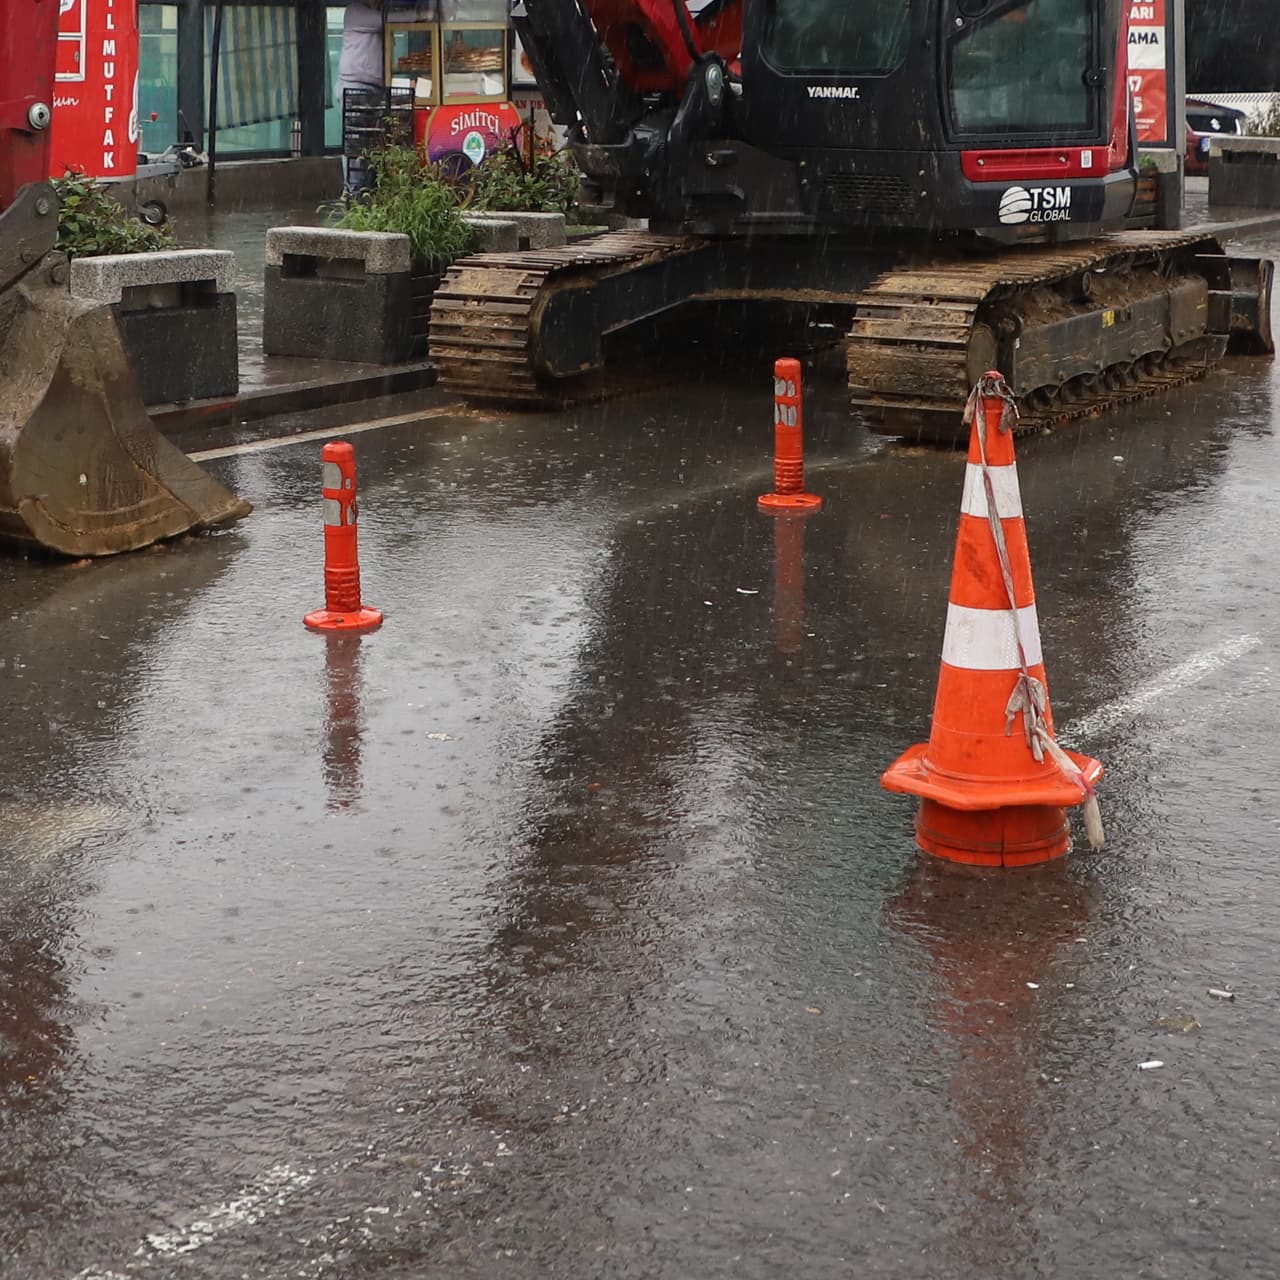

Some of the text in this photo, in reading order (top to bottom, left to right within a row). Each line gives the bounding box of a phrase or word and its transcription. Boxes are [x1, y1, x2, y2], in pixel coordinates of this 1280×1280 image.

[102, 39, 116, 169] MUTFAK
[807, 86, 860, 99] YANMAR
[450, 108, 499, 135] SİMİTÇİ
[1030, 186, 1071, 209] TSM
[1030, 209, 1072, 223] GLOBAL
